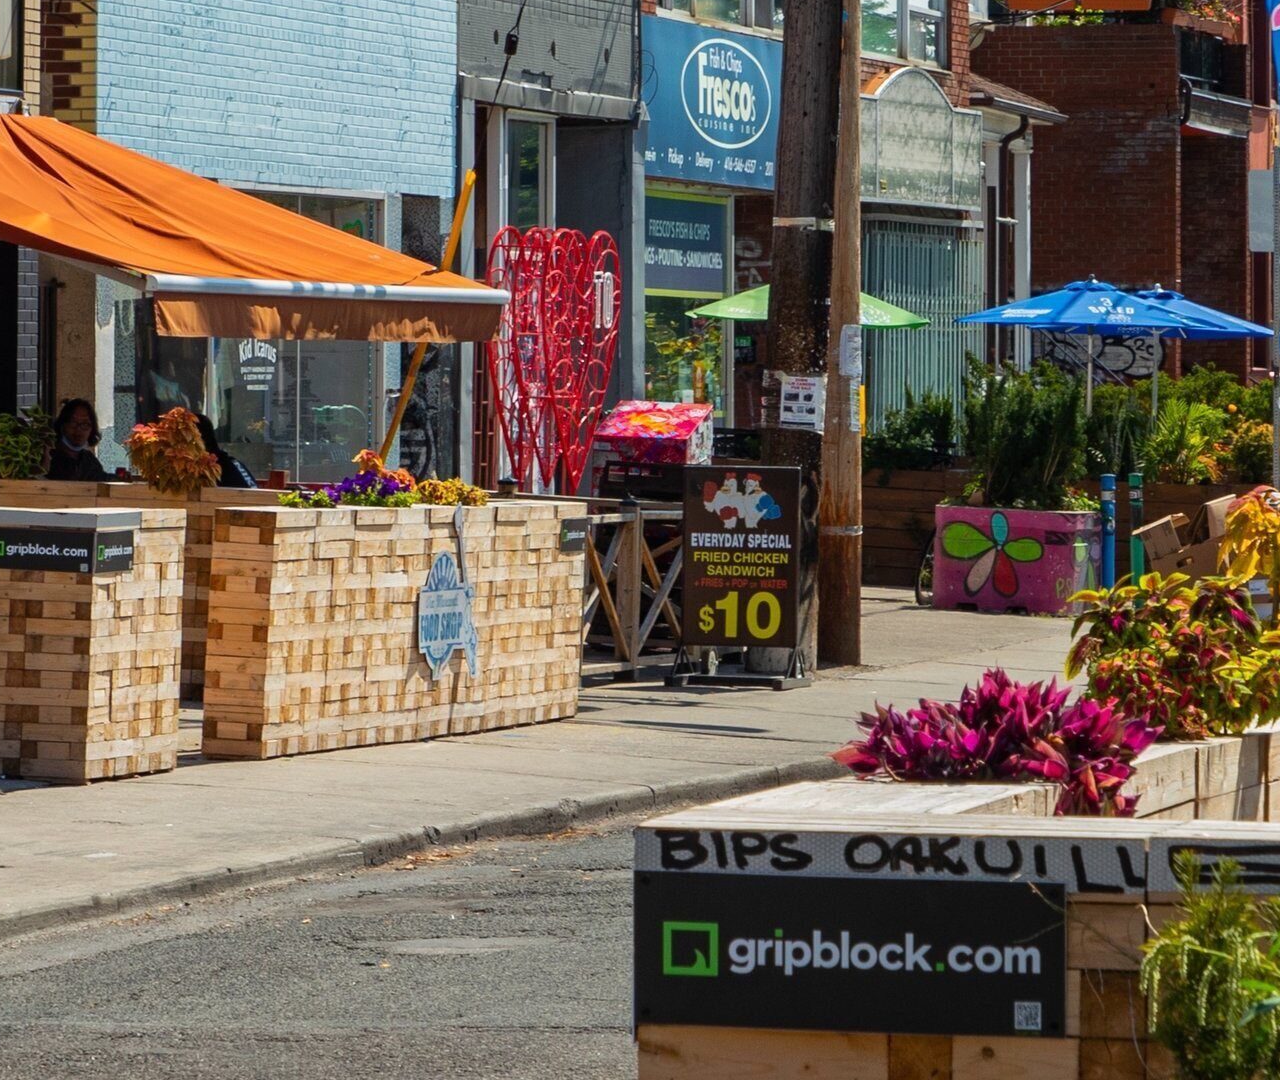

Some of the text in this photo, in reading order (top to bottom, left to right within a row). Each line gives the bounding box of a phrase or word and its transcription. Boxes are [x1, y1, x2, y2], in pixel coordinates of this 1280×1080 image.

[709, 47, 743, 78] Fish & Chips
[698, 52, 756, 122] Fresco's
[695, 151, 714, 173] Delivery
[649, 219, 711, 241] FRESCO'S FISH & CHIPS
[658, 248, 683, 267] POUTINE
[686, 250, 723, 270] SANDWICHES
[239, 337, 277, 363] Kid Icarus
[6, 542, 88, 558] gripblock.com
[691, 533, 792, 549] EVERYDAY SPECIAL
[694, 551, 789, 564] FRIED CHICKEN
[707, 565, 775, 577] SANDWICH
[700, 578, 724, 588] FRIES
[731, 579, 748, 588] POP
[760, 579, 788, 589] WATER
[420, 611, 463, 642] FOOD SHOP
[699, 591, 781, 640] $10
[655, 828, 813, 872] BIPS
[728, 928, 1041, 976] gripblock.com
